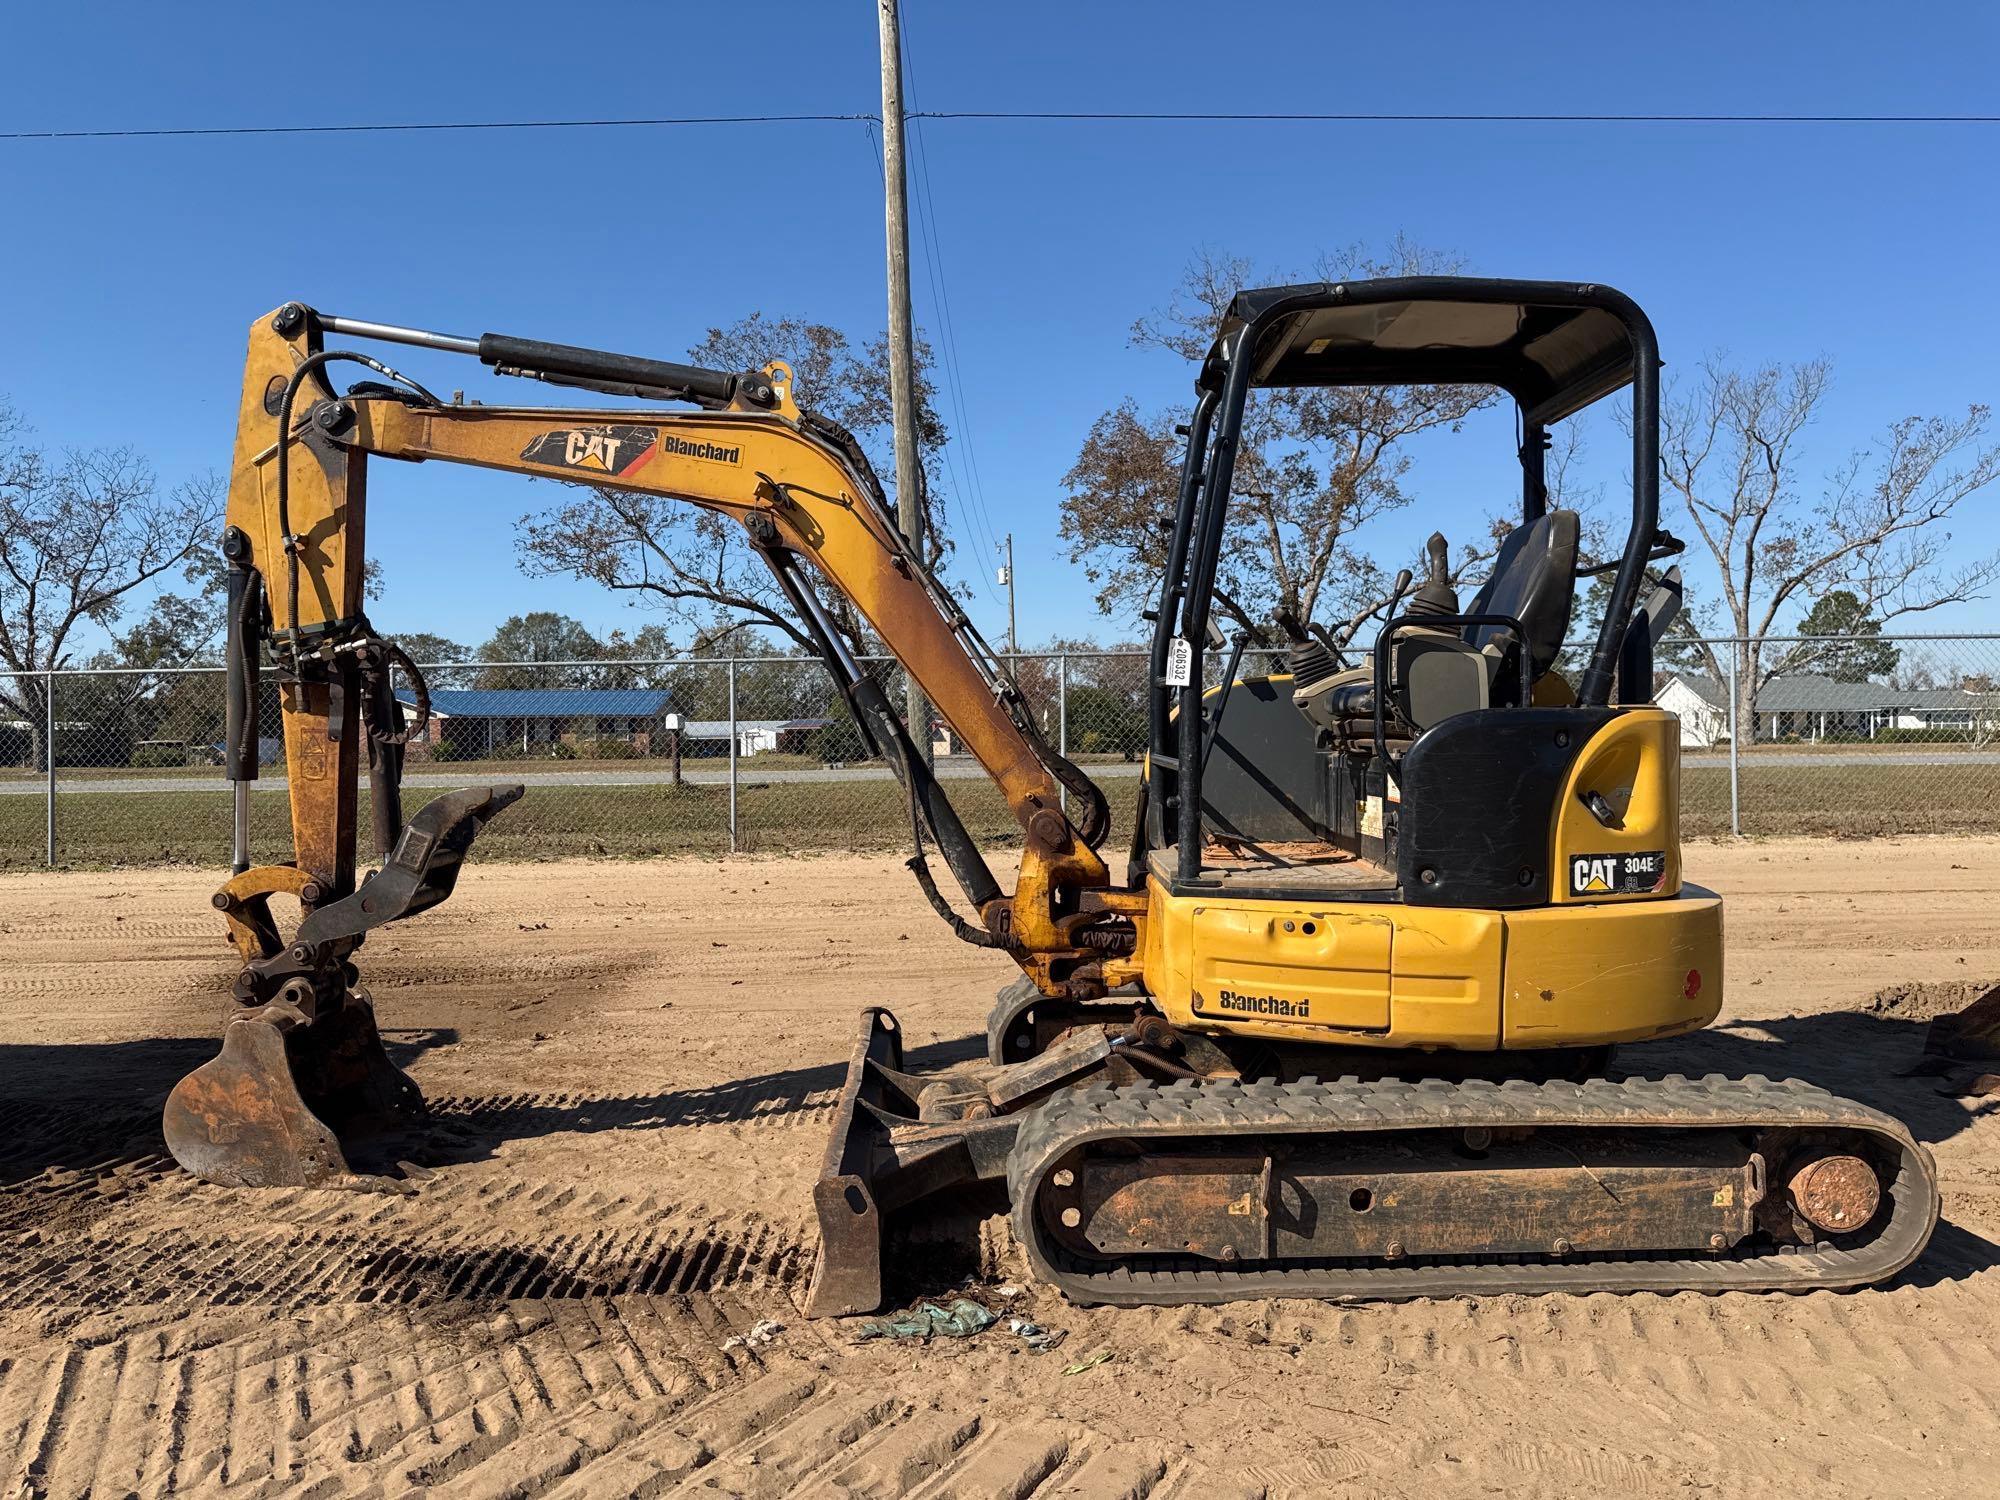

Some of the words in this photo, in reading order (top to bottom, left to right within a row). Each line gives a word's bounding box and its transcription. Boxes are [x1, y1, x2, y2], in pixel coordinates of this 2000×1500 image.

[565, 432, 621, 472] CAT
[664, 436, 740, 464] Blanchard
[1174, 648, 1187, 680] 206332
[1574, 859, 1617, 891] CAT
[1220, 990, 1310, 1018] Blanchard
